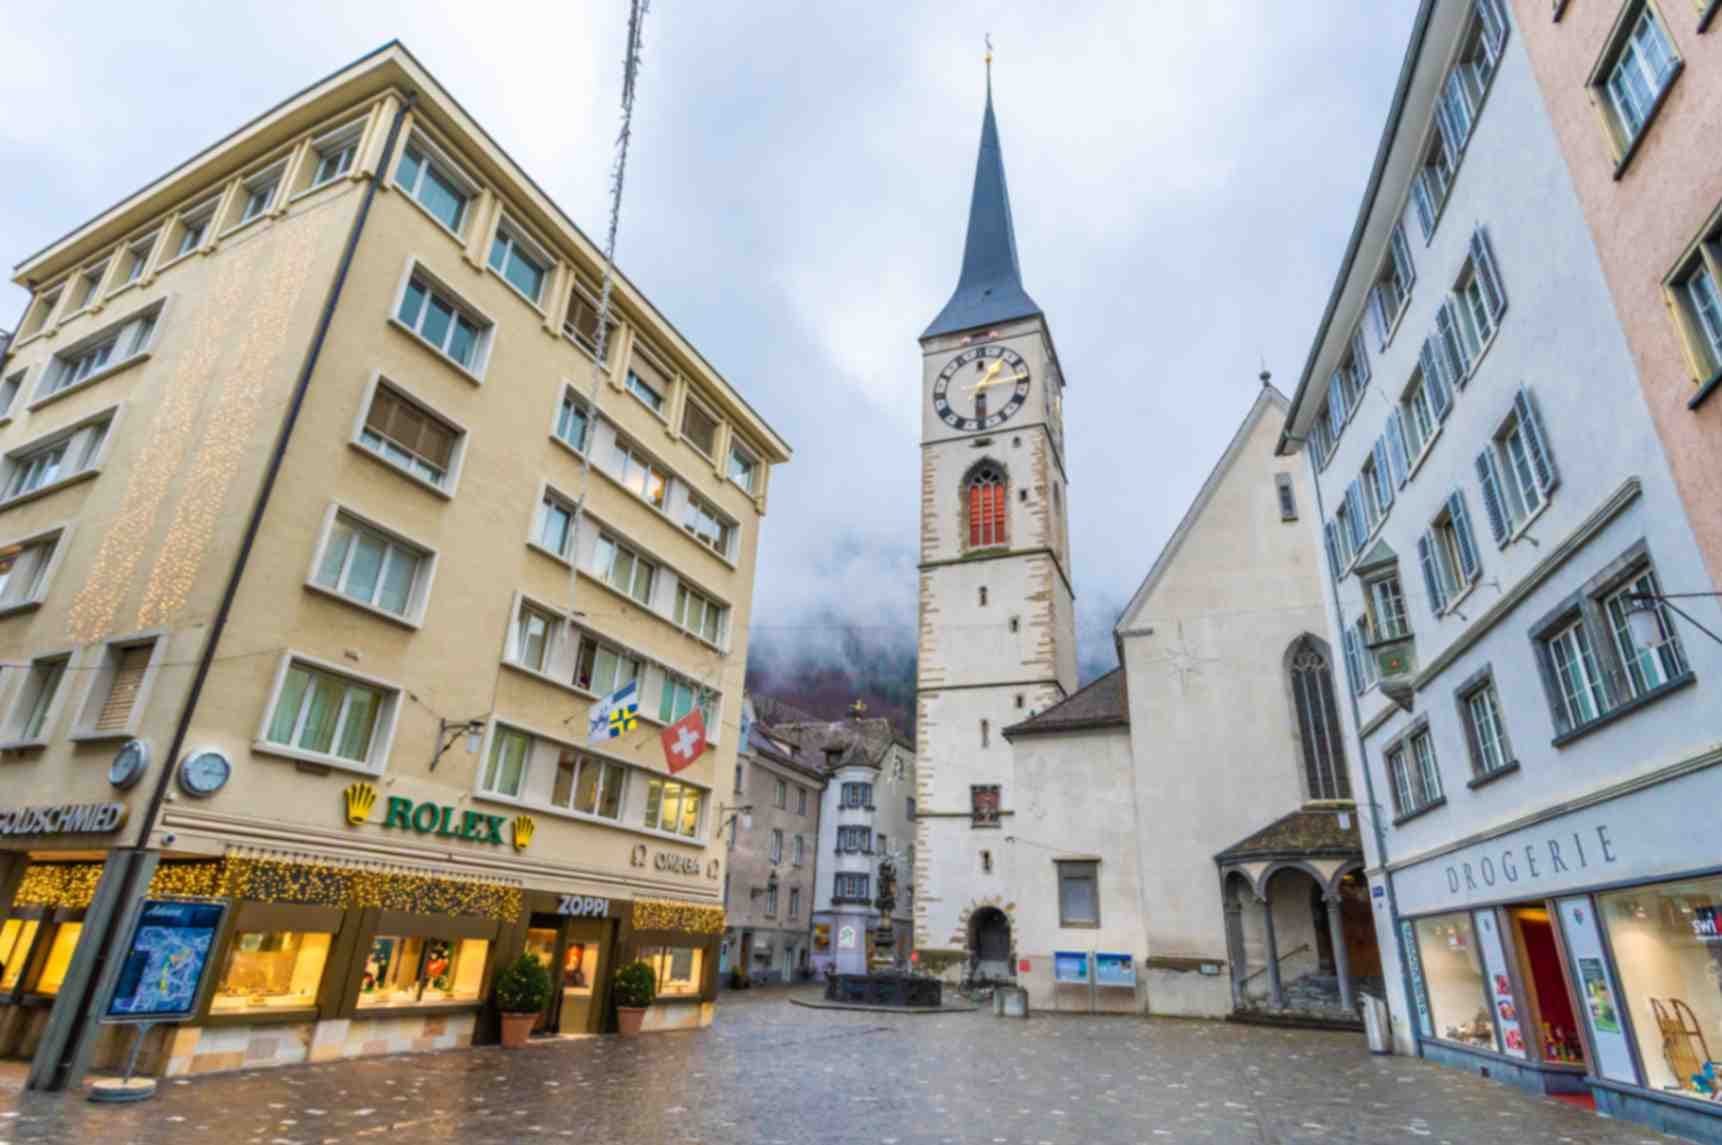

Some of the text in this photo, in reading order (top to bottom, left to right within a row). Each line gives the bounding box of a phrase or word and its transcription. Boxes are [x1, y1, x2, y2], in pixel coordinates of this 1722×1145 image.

[382, 796, 507, 845] ROLEX
[1445, 824, 1616, 894] DROGERIE
[558, 895, 609, 918] ZOPPI
